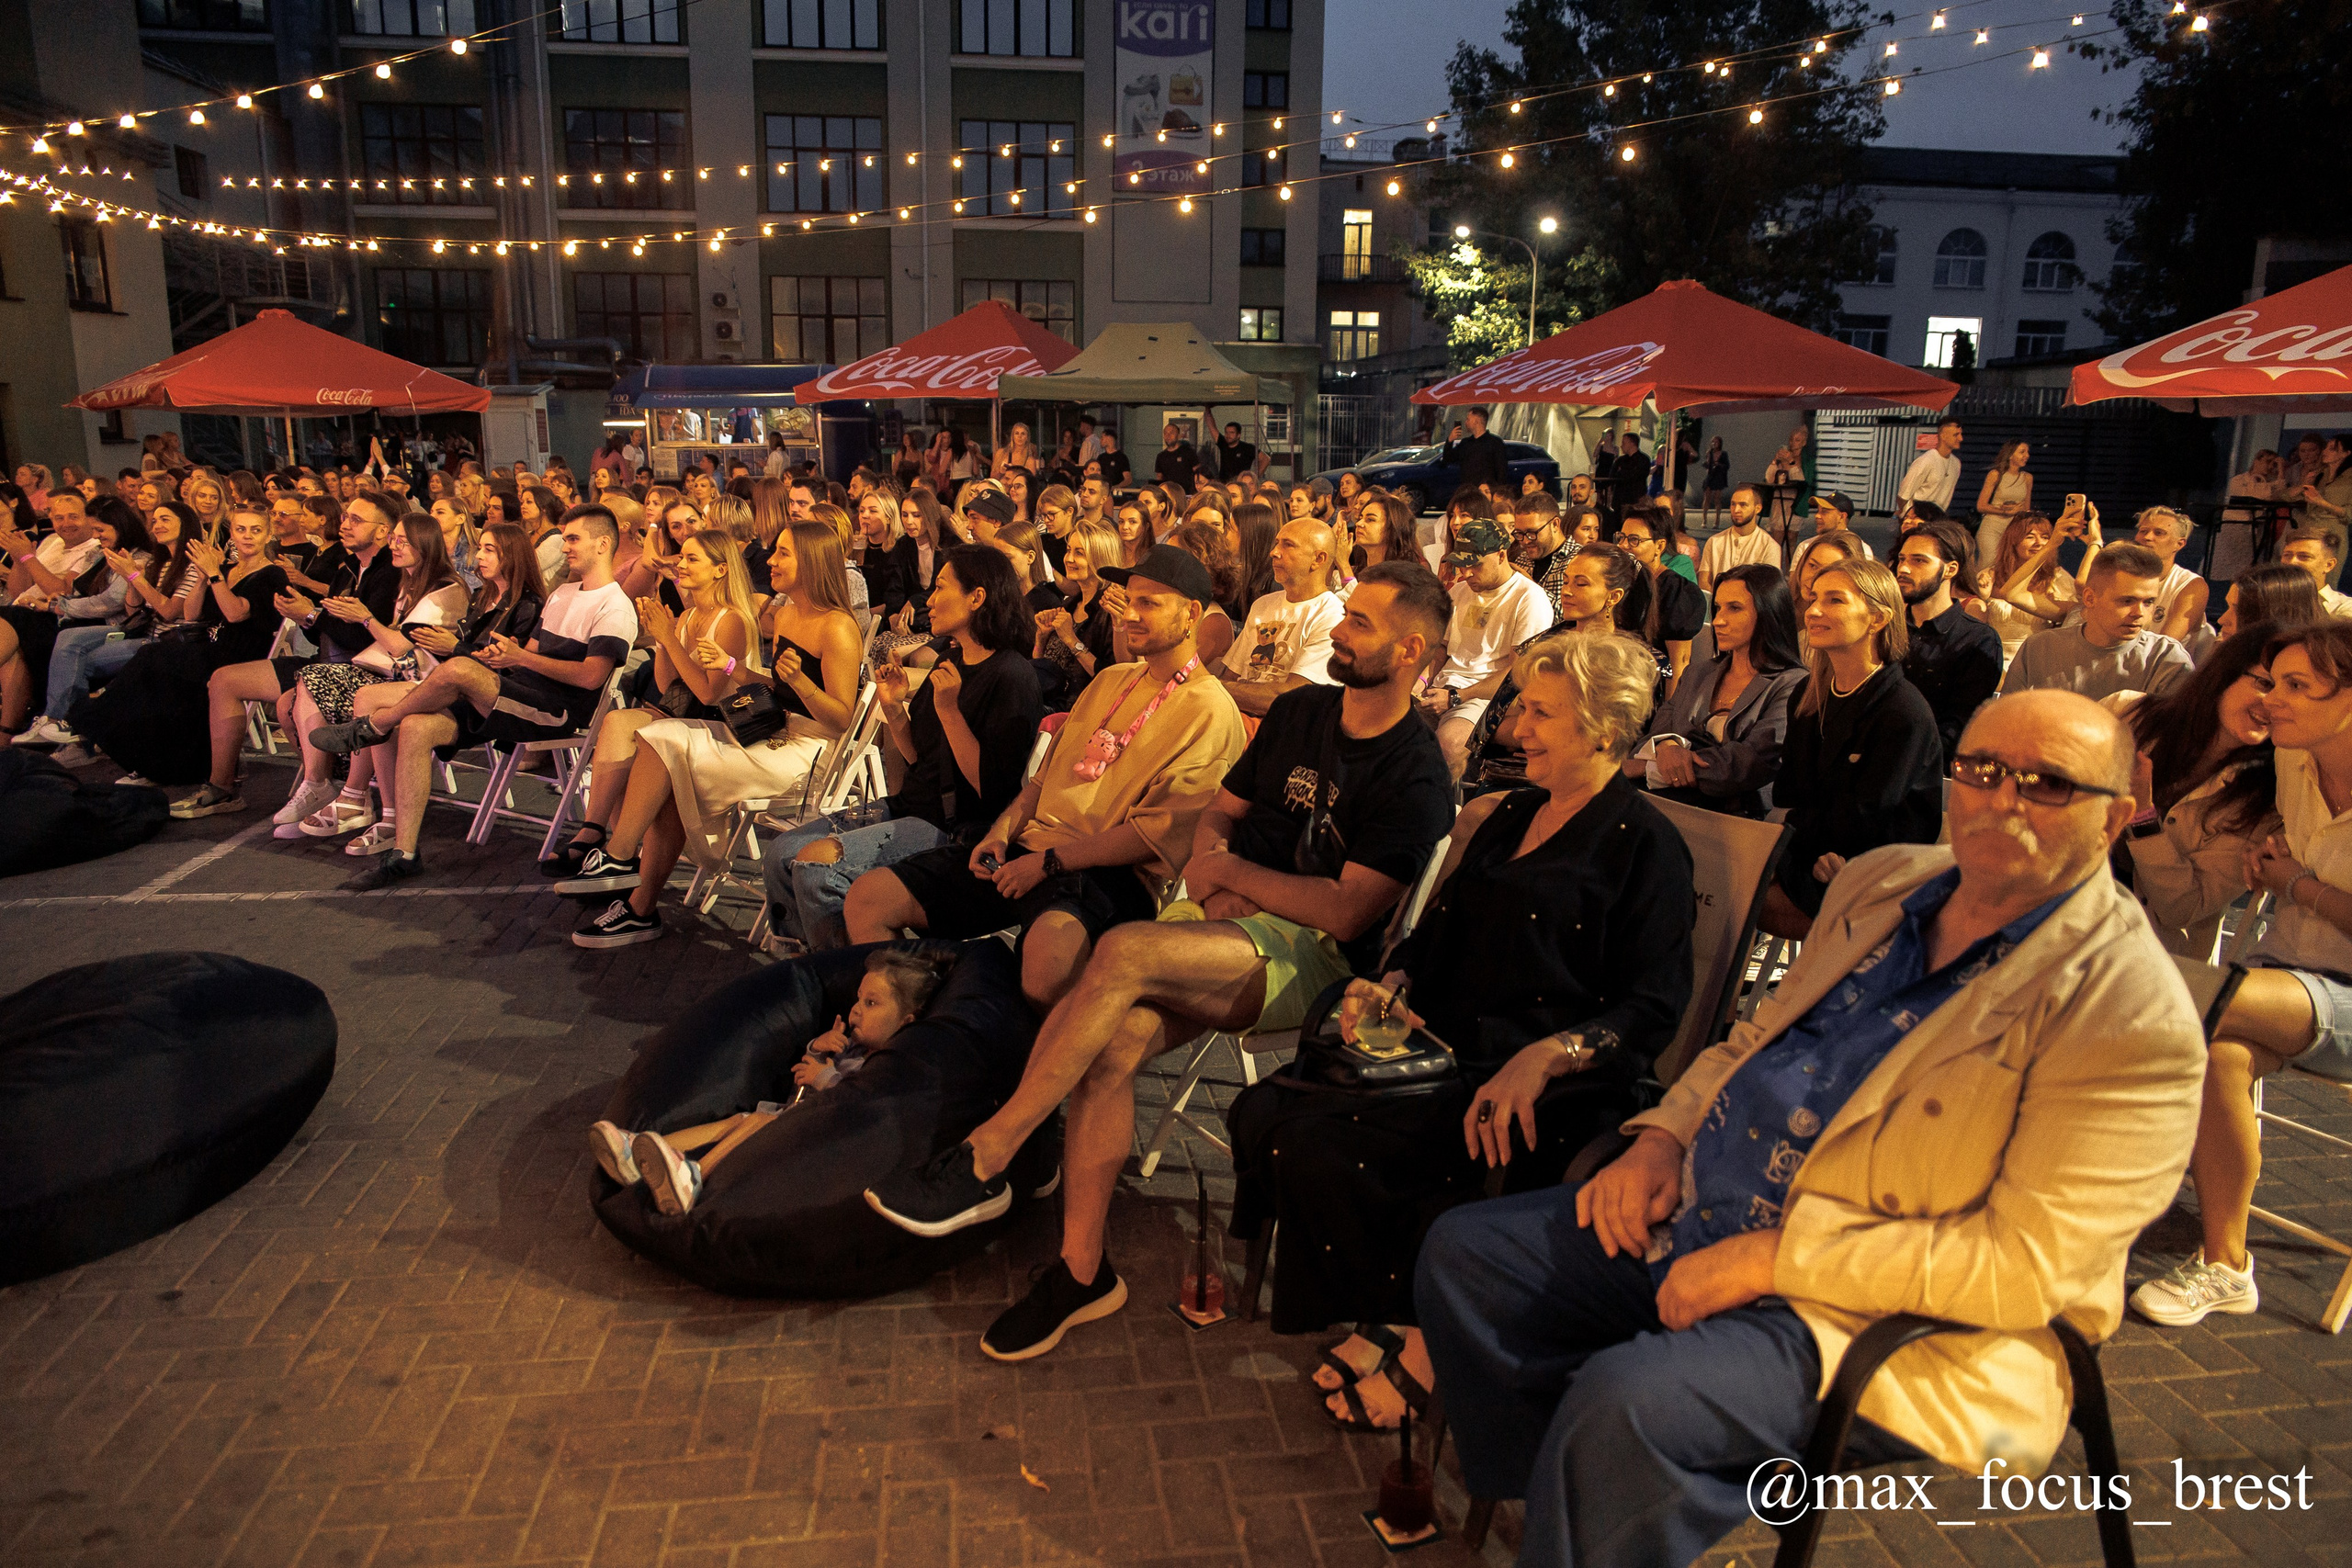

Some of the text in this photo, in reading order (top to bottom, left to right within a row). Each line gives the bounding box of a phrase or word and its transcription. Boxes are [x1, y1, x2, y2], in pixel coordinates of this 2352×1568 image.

[1121, 1, 1209, 40] kari
[1147, 169, 1195, 182] этаж
[316, 387, 373, 405] Coca-Cola
